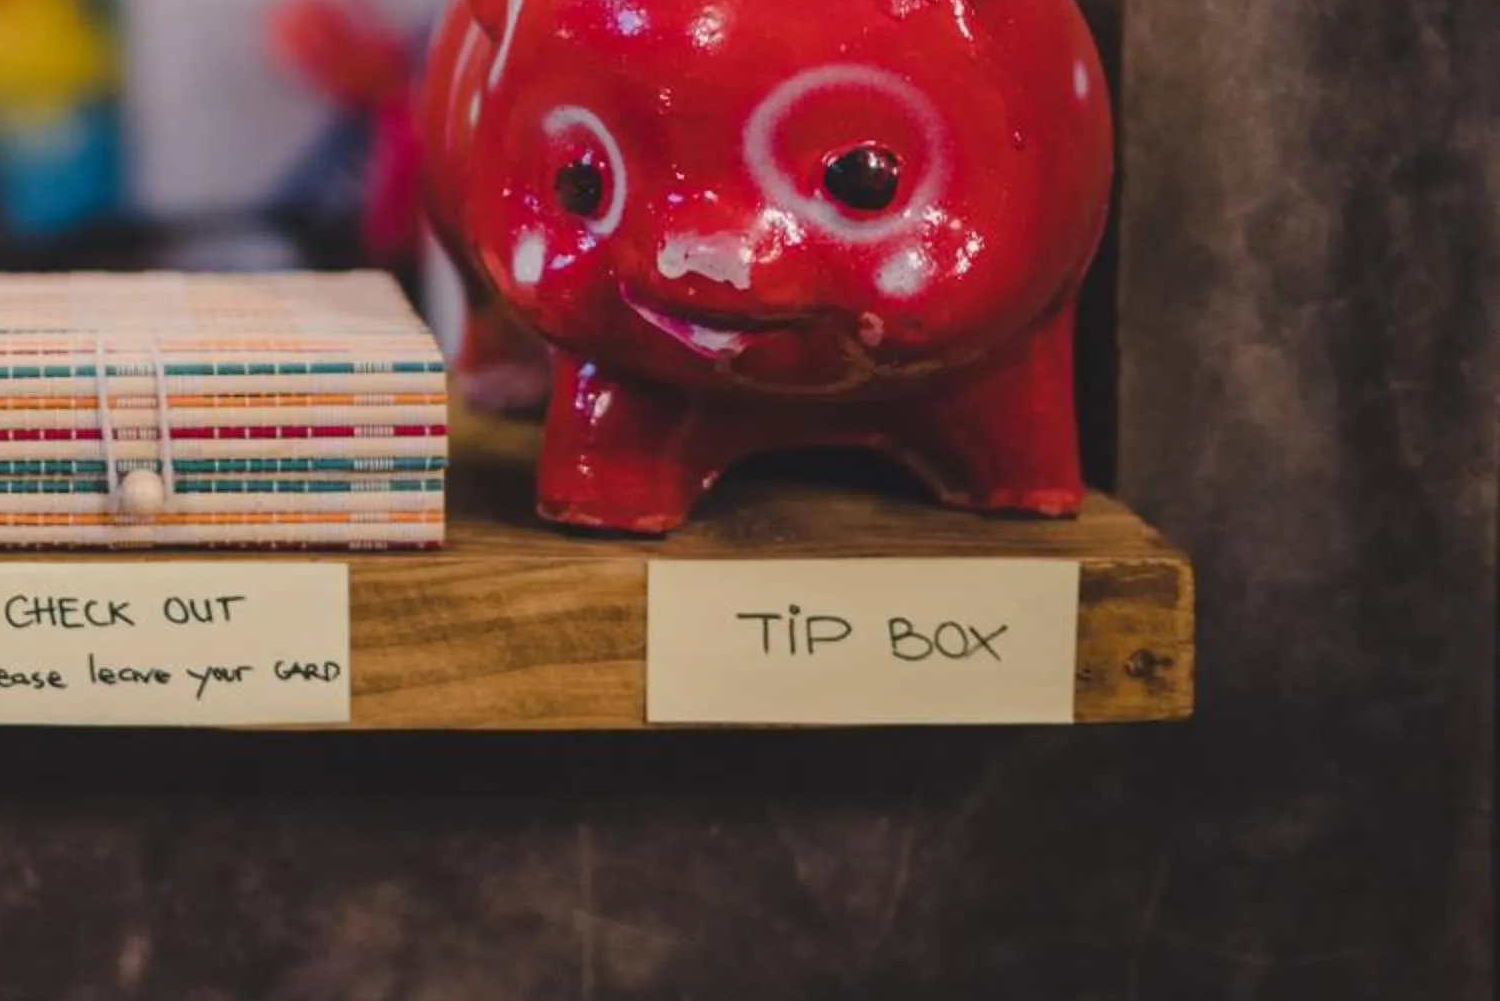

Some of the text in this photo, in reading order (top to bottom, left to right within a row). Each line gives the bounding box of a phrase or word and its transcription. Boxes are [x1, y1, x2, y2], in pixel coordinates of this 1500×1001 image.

[4, 594, 247, 629] CHECK OUT
[888, 616, 1008, 662] BOX
[88, 653, 171, 686] leave
[186, 665, 253, 700] your
[274, 660, 341, 683] CARD
